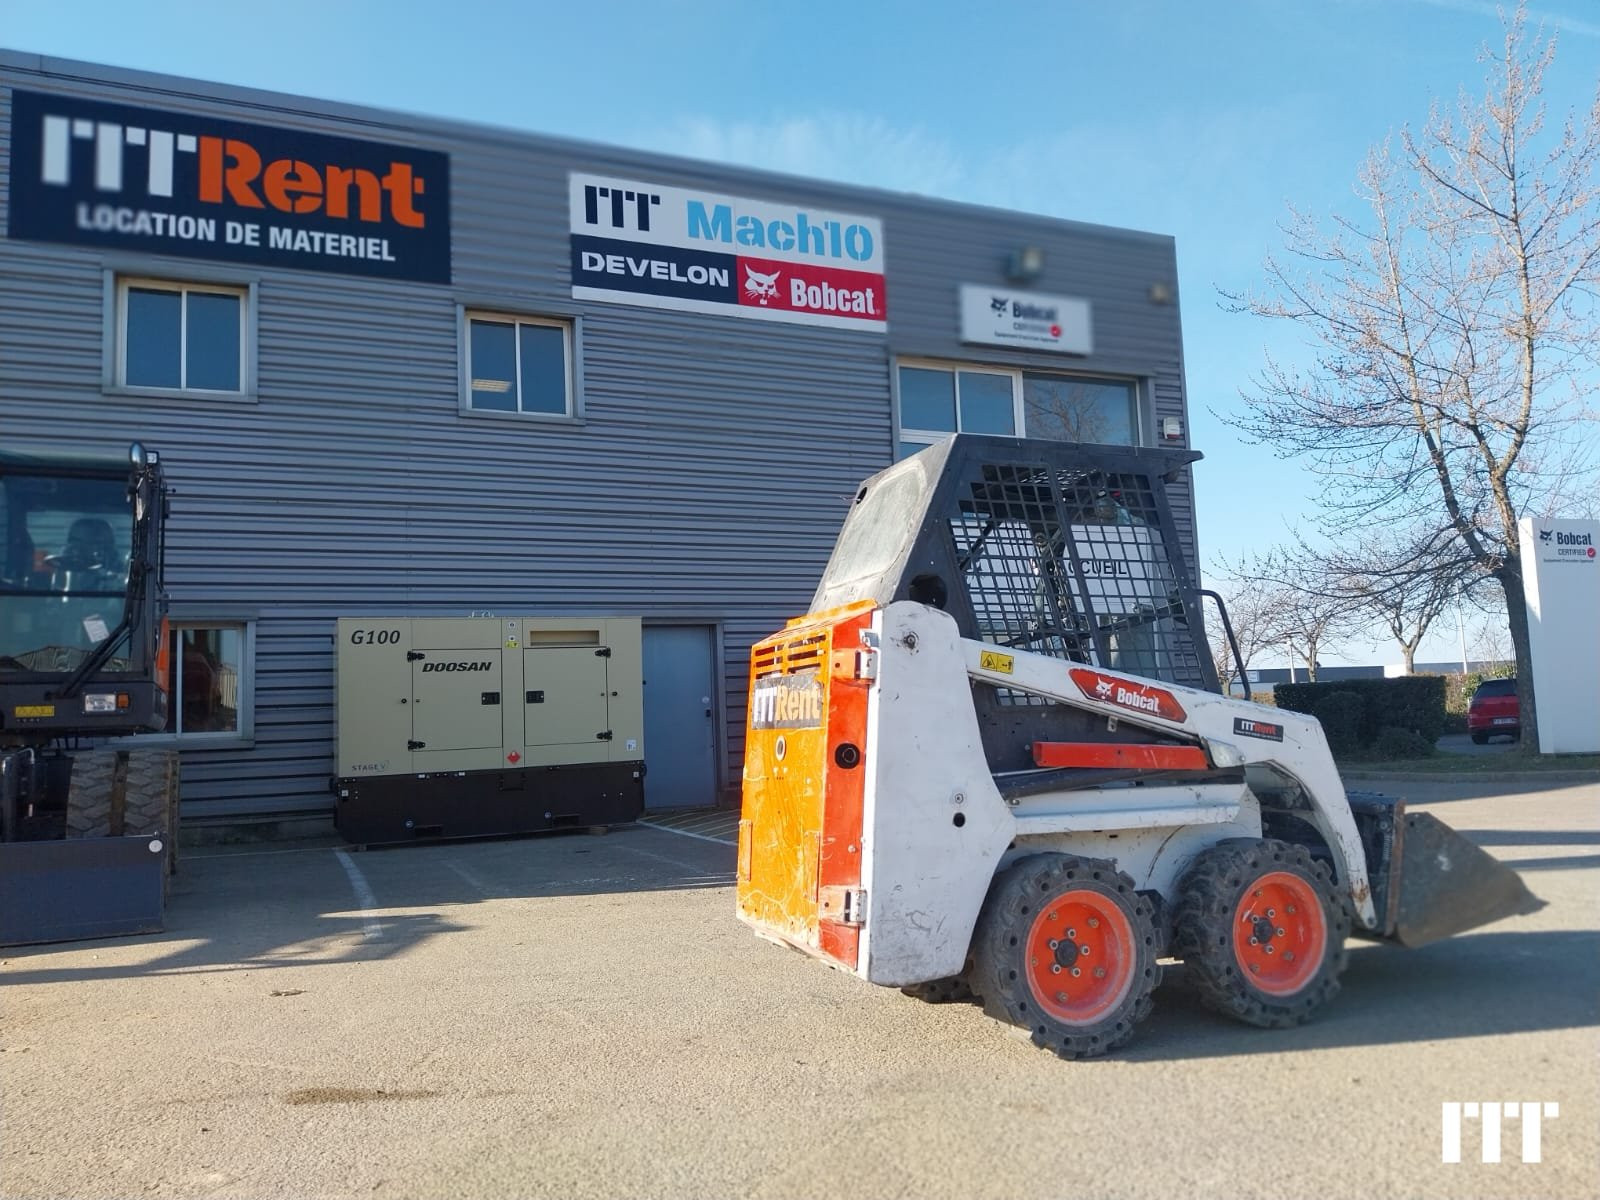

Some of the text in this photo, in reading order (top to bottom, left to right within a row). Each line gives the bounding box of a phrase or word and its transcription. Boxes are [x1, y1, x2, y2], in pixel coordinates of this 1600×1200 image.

[76, 202, 397, 262] LOCATION DE MATERIEL
[581, 251, 730, 288] DEVELON
[790, 278, 876, 316] Bobcat
[1556, 531, 1593, 546] Bobcat
[1068, 560, 1127, 575] CUEIL
[350, 629, 400, 645] G100
[421, 661, 493, 673] DOOSAN
[1116, 687, 1160, 712] Bobcat
